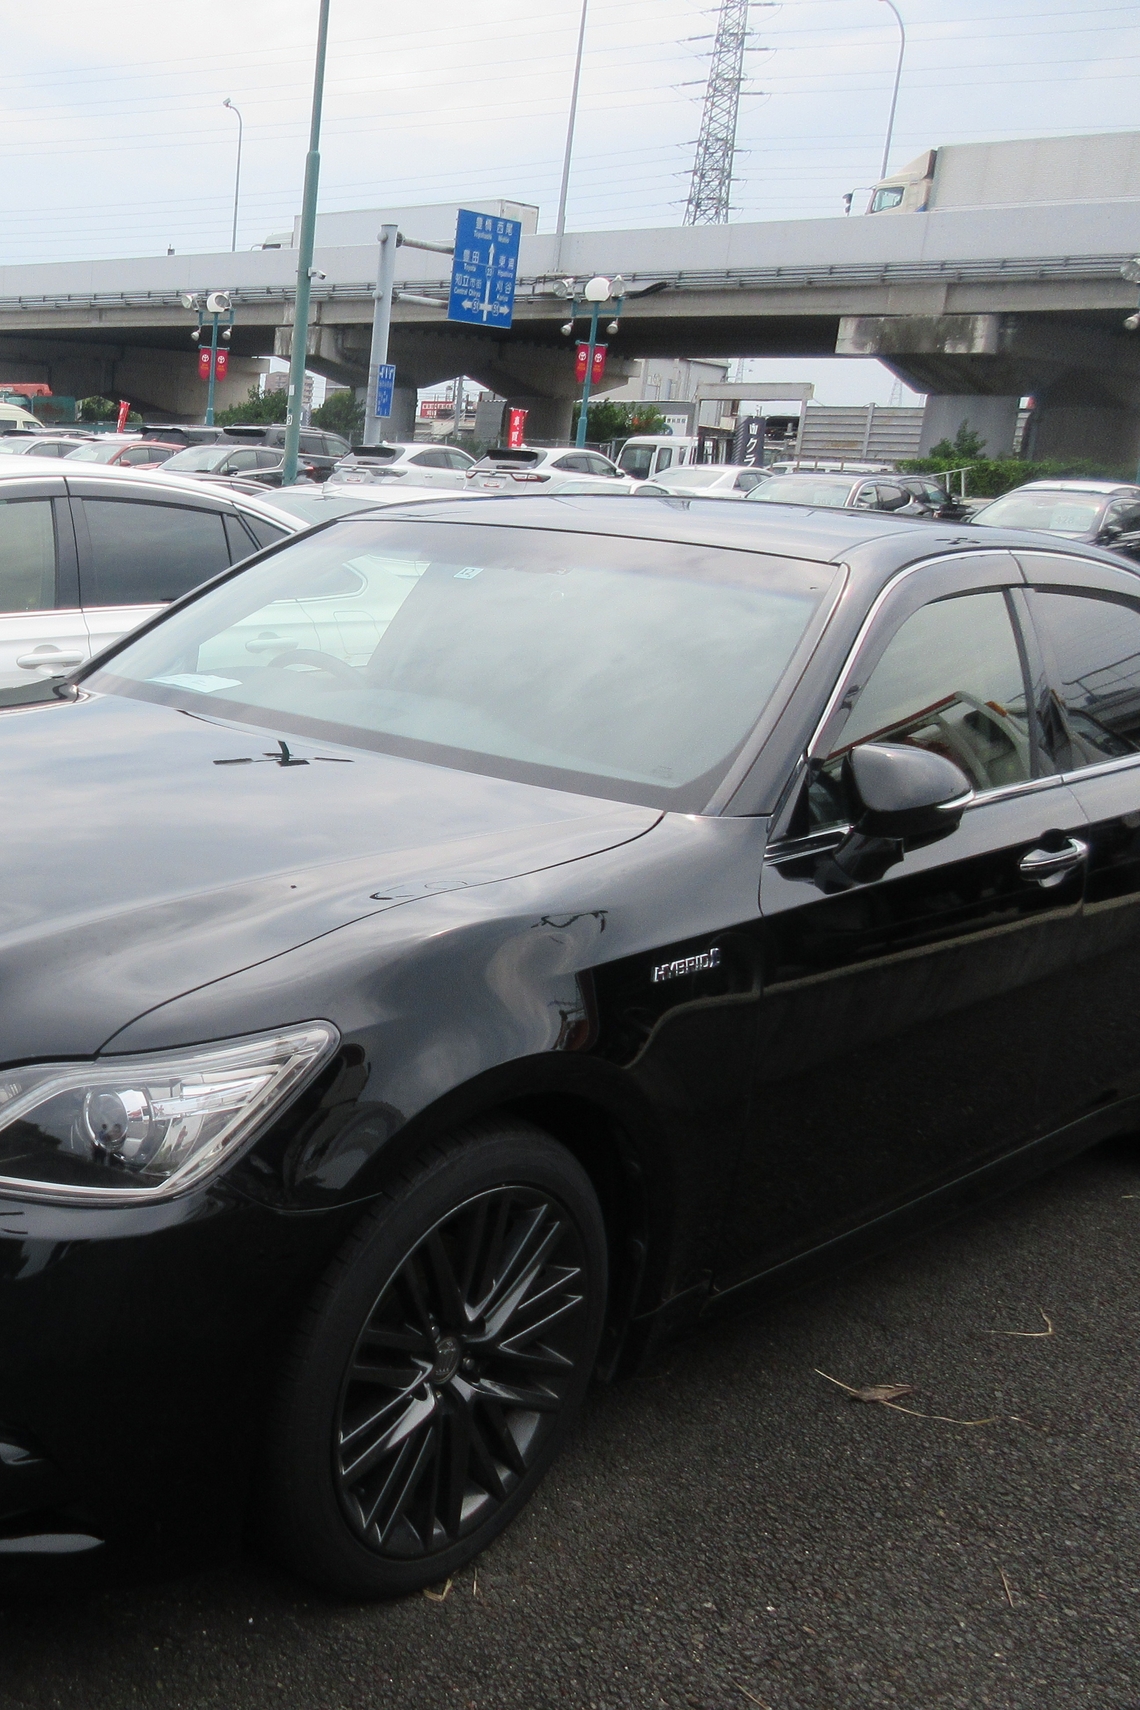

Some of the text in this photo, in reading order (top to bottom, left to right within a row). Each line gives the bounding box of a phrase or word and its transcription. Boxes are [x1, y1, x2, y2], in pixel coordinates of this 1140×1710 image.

[496, 221, 513, 236] 西尾
[463, 249, 479, 264] 豊田
[496, 280, 512, 294] 刈谷
[653, 953, 709, 982] HYBRID
